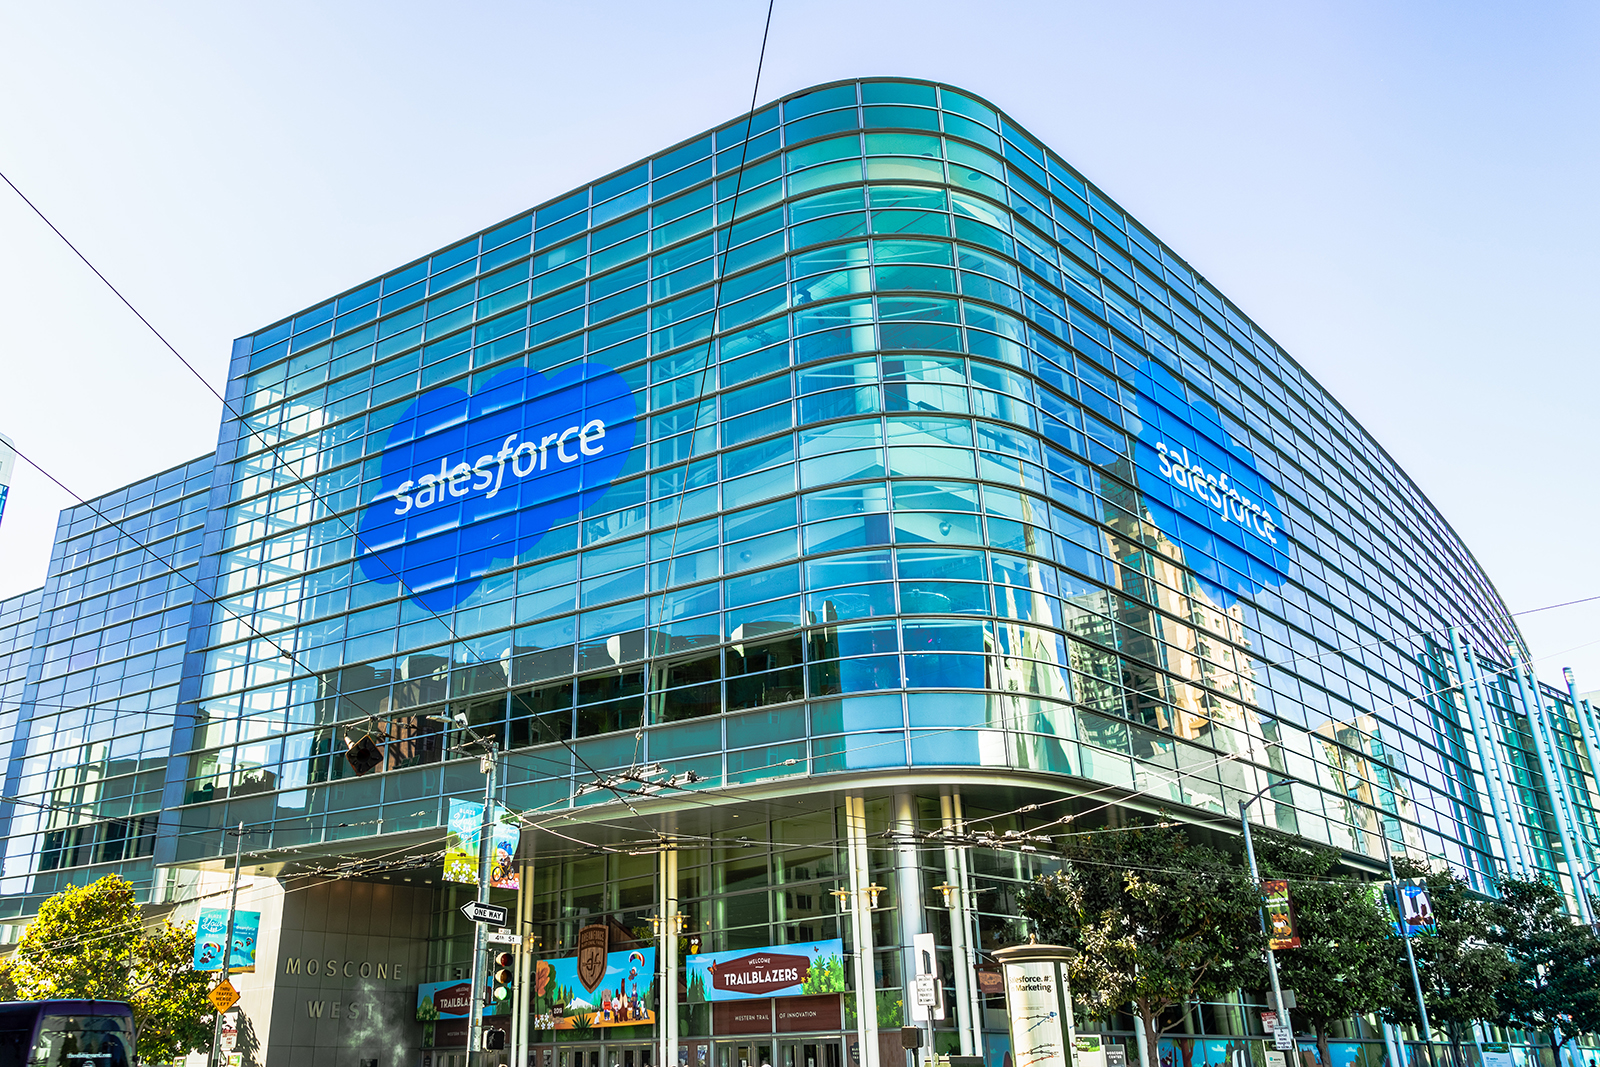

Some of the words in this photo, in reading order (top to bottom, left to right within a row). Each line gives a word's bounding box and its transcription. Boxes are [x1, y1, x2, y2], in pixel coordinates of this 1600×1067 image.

[394, 418, 606, 516] salesforce
[1156, 441, 1278, 545] salesforce
[474, 908, 487, 917] ONE
[489, 911, 502, 919] WAY
[285, 957, 403, 980] MOSCONE
[748, 957, 771, 966] WELCOME
[724, 967, 799, 986] TRAILBLAZERS
[307, 1001, 374, 1019] WEST
